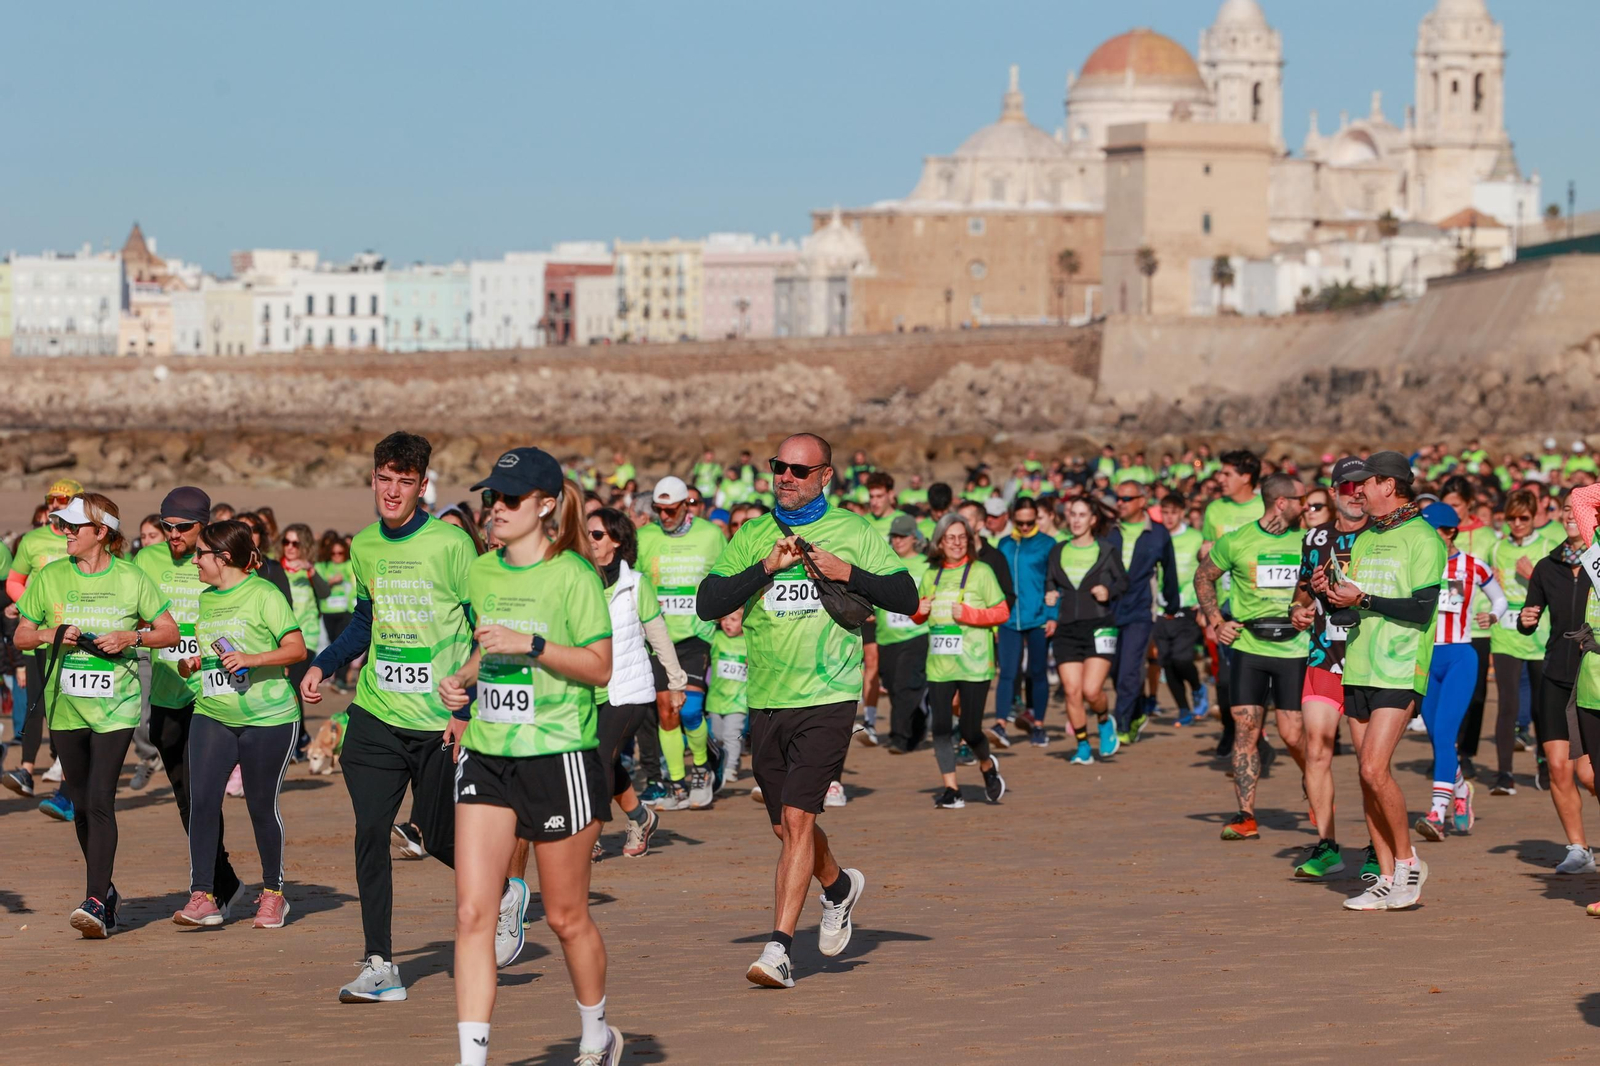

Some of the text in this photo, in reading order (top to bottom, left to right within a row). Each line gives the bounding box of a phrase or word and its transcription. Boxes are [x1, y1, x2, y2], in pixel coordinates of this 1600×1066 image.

[1305, 528, 1328, 546] 18
[1267, 568, 1299, 580] 1721
[160, 583, 174, 593] En
[376, 577, 434, 589] En marcha
[376, 592, 434, 606] contra el
[775, 584, 820, 601] 2500
[65, 603, 126, 616] En marcha
[665, 598, 694, 609] 1122
[377, 605, 436, 622] cáncer
[63, 616, 124, 629] contra el
[211, 617, 247, 628] marcha
[497, 617, 548, 633] marcha
[233, 628, 245, 639] el
[933, 637, 960, 648] 2767
[69, 672, 111, 689] 1175
[384, 665, 429, 684] 2135
[483, 687, 529, 711] 1049
